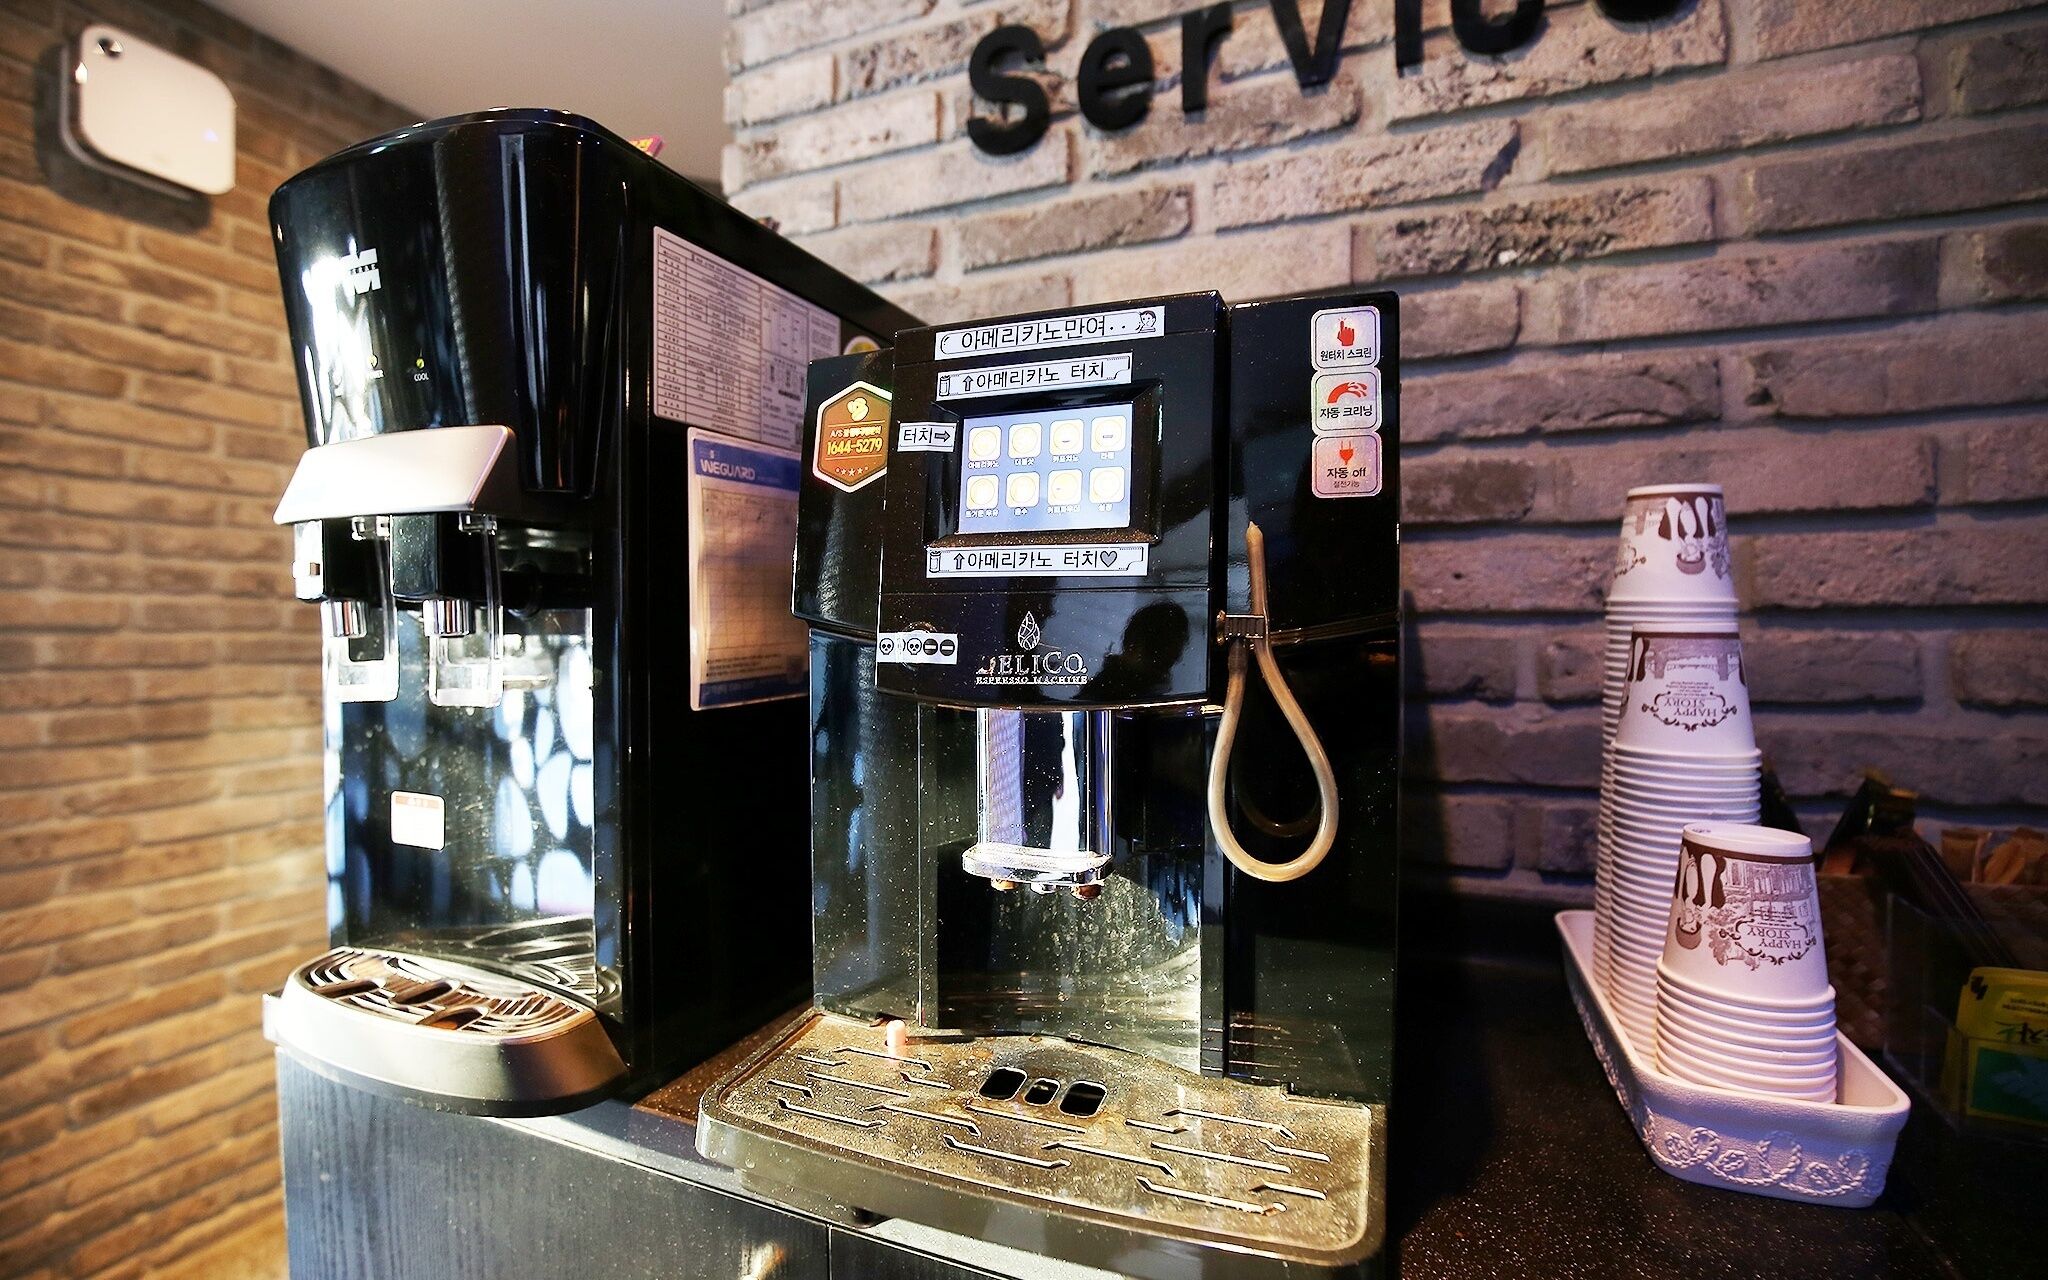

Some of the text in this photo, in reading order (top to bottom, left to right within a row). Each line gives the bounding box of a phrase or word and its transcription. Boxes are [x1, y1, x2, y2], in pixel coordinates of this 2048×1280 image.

[1320, 347, 1372, 361] 원터치 스크린
[413, 372, 429, 382] COOL
[976, 361, 1105, 390] 아메리카노 터치
[1320, 405, 1373, 418] 자동 크리닝
[903, 427, 933, 443] 터치
[827, 437, 883, 456] 1644-5279
[700, 458, 756, 480] WEGUARD
[1327, 467, 1367, 478] 자동 off
[967, 550, 1098, 569] 아메리카노 터치
[976, 675, 1088, 685] ESPRESSO MACHINE
[1664, 698, 1705, 708] STORY
[1673, 707, 1717, 717] HAPPY
[1747, 926, 1791, 939] STORY
[1758, 938, 1801, 949] HAPPY
